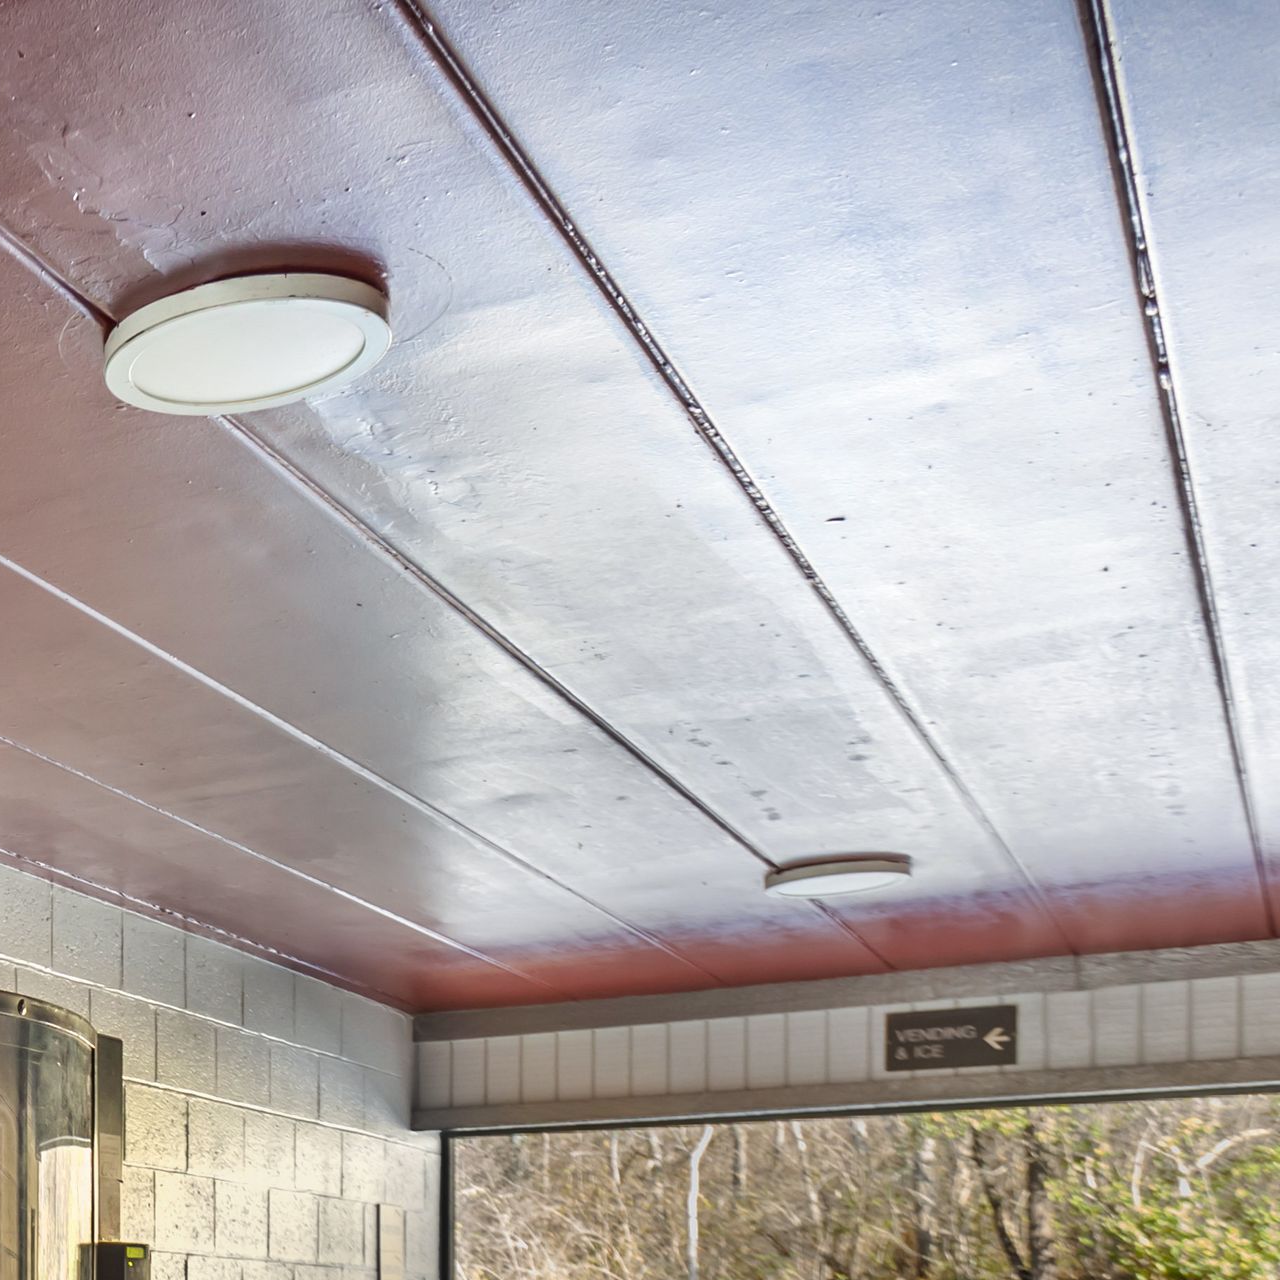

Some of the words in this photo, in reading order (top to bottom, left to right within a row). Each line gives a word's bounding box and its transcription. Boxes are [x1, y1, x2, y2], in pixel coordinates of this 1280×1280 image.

[895, 1025, 977, 1043] VENDING
[894, 1046, 908, 1060] &
[913, 1044, 944, 1059] ICE
